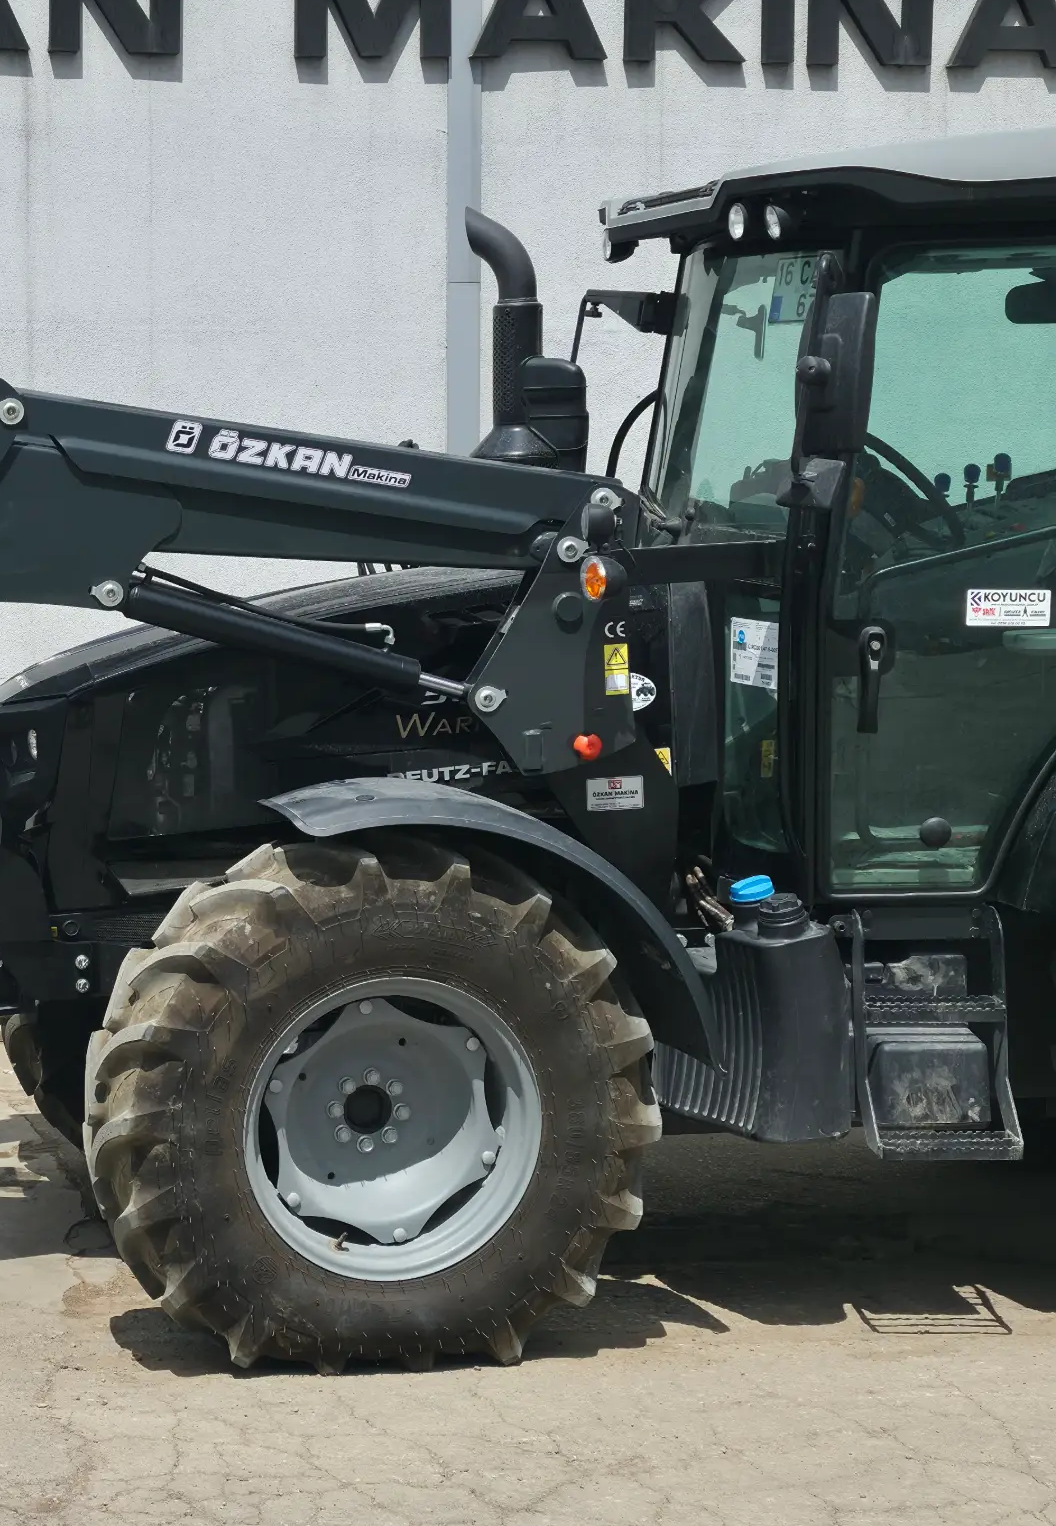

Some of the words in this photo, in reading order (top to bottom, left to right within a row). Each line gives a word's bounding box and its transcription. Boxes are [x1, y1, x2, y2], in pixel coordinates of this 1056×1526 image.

[778, 260, 795, 287] 16
[208, 428, 354, 478] ÖZKAN
[351, 468, 408, 487] Makina
[983, 591, 1046, 603] KOYUNCU
[604, 621, 626, 638] CE
